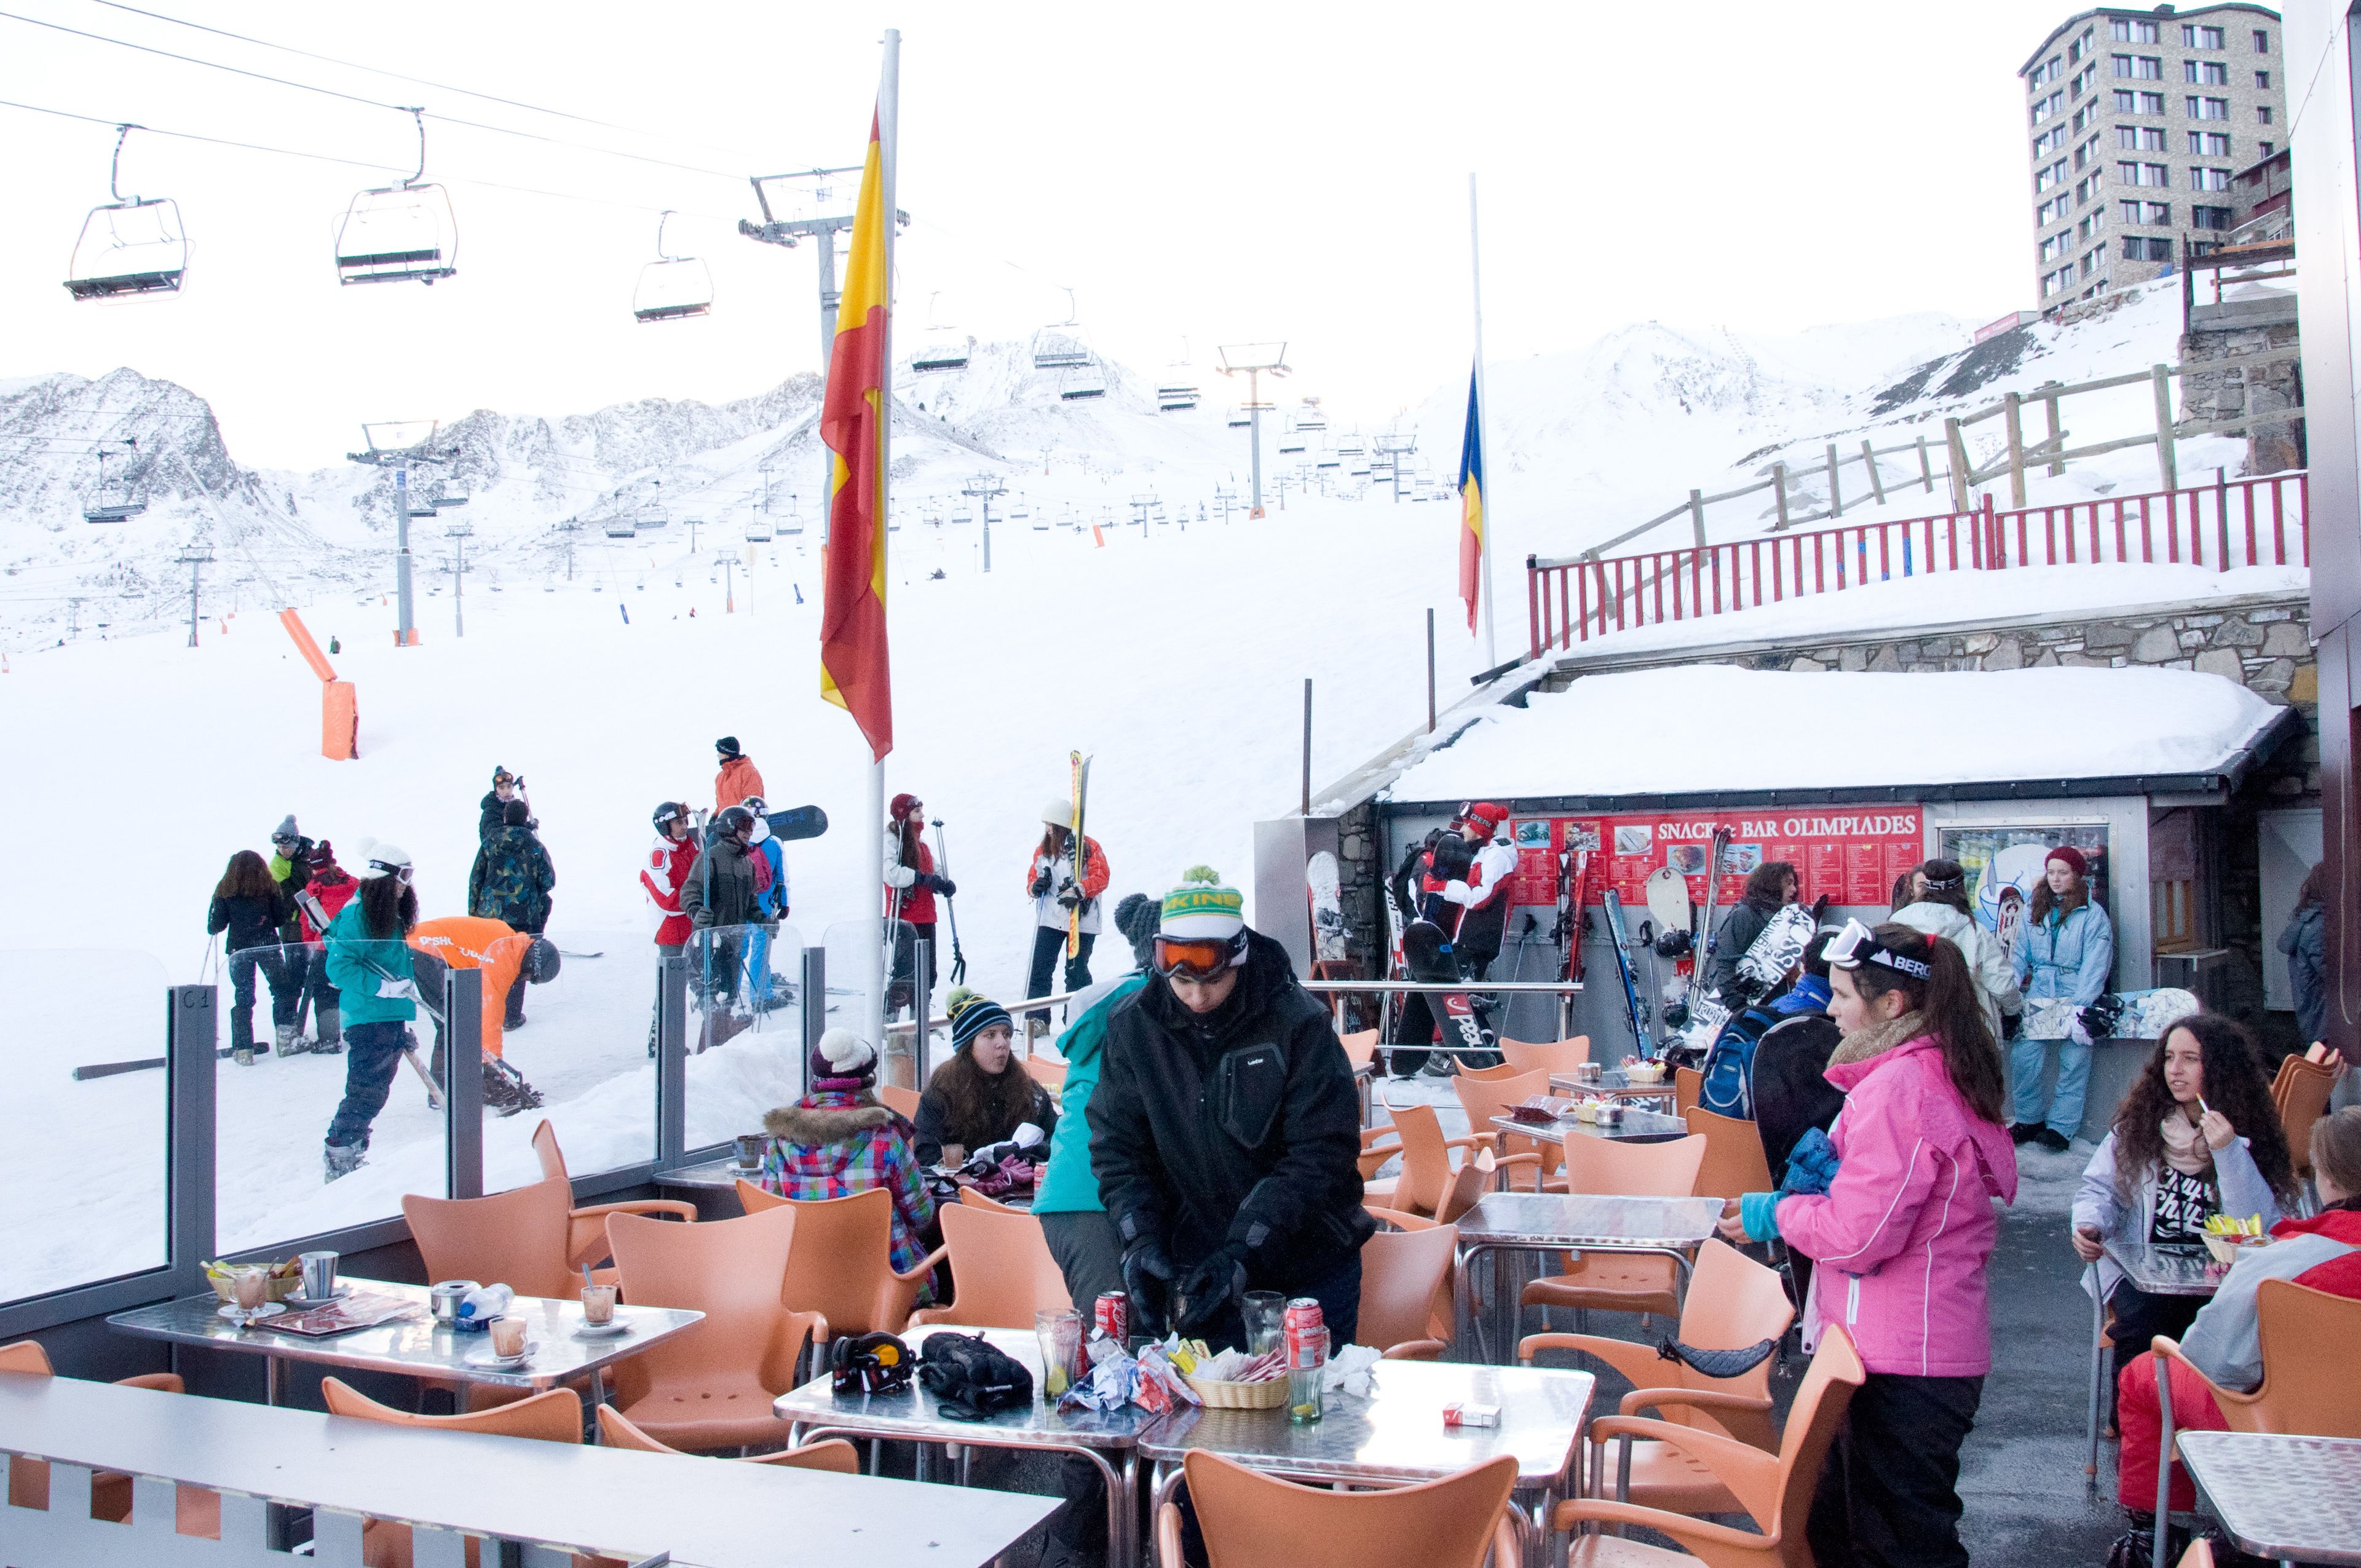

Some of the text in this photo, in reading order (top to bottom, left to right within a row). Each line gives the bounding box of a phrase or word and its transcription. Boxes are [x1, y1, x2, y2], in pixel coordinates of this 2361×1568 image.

[1658, 822, 1718, 840] SNACK
[1741, 820, 1779, 837] BAR
[1783, 815, 1917, 837] OLIMPIADES
